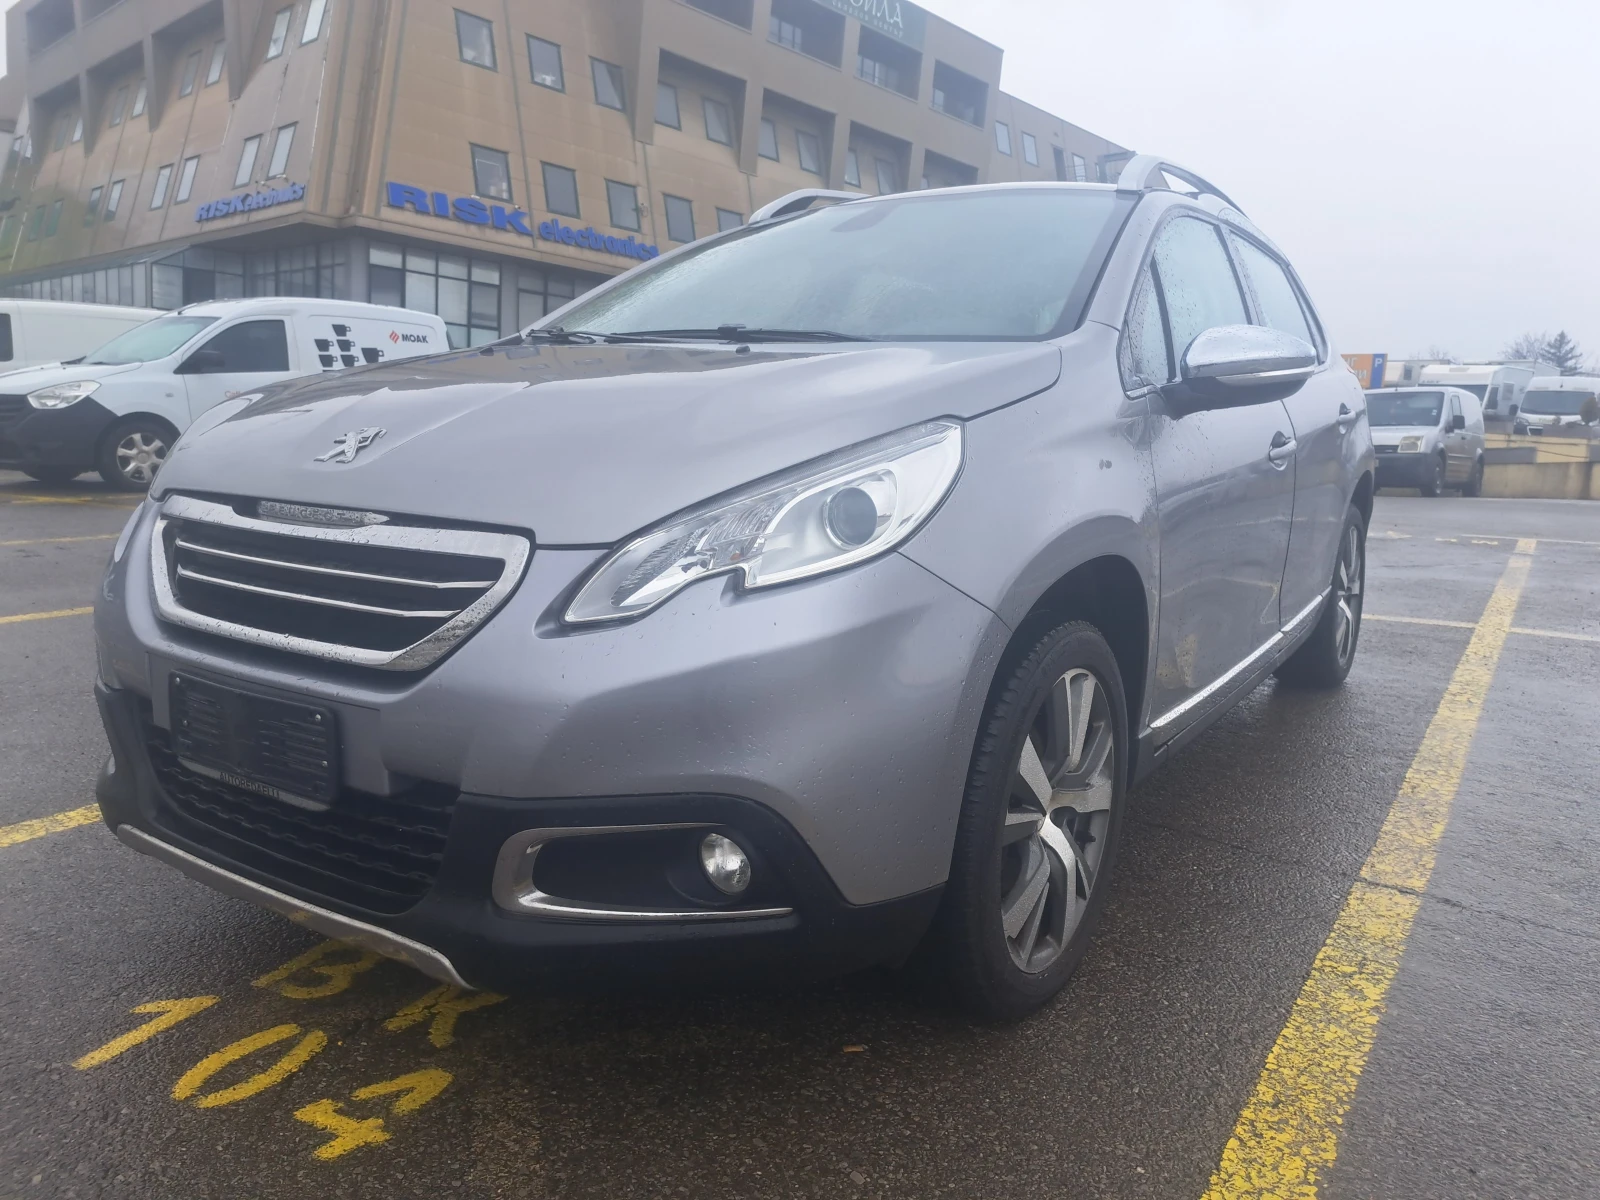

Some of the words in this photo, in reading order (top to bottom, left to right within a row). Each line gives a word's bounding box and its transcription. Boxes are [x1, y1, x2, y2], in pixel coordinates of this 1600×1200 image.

[195, 193, 252, 222] RISK
[387, 181, 533, 236] RISK
[539, 218, 659, 261] electronics
[401, 332, 429, 344] MOAK
[72, 994, 454, 1161] 104
